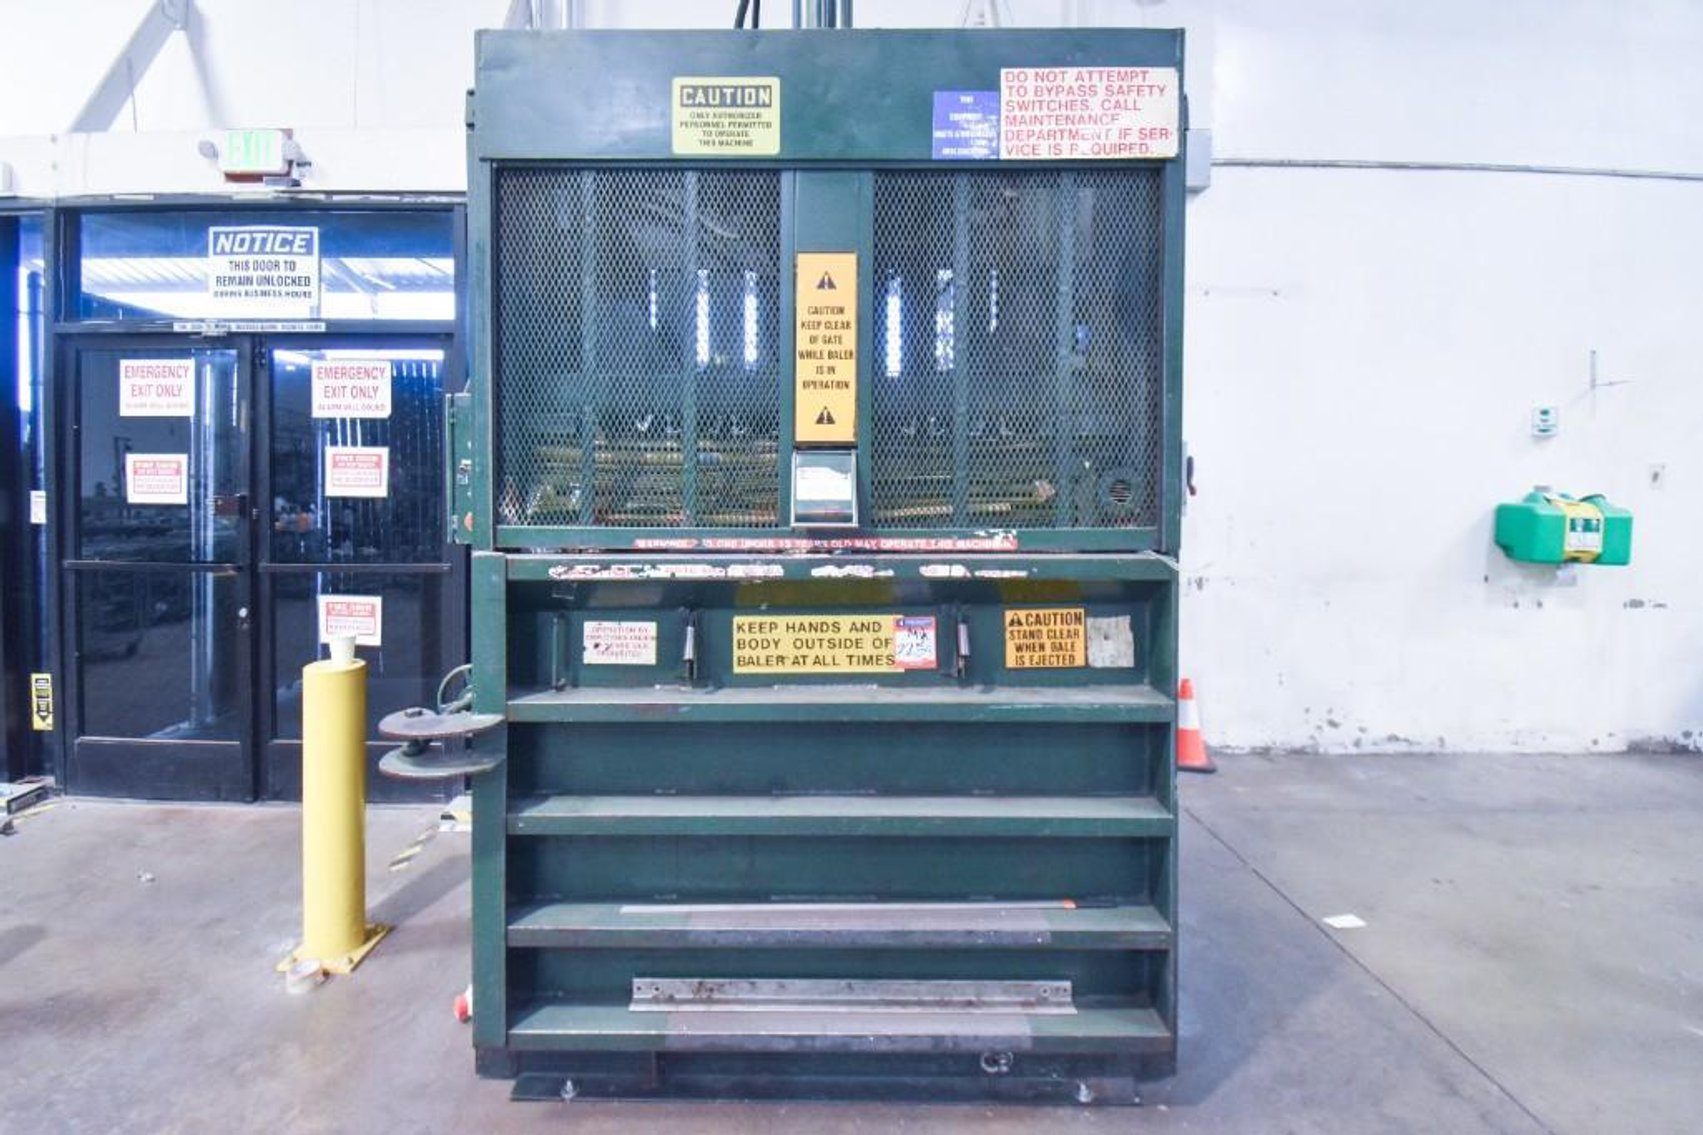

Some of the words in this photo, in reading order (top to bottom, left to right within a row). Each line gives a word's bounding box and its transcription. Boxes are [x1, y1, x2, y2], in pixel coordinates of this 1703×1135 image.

[1005, 70, 1027, 82] DO
[1034, 70, 1067, 82] NOT
[1075, 70, 1149, 82] ATTEMPT
[682, 87, 770, 105] CAUTION
[1008, 85, 1027, 97] TO
[1034, 85, 1098, 97] BYPASS
[1105, 84, 1167, 97] SAFETY
[1100, 98, 1142, 111] CALL
[1119, 128, 1132, 141] IF
[225, 131, 276, 166] EXIT
[1005, 143, 1041, 156] VICE
[1048, 143, 1063, 156] IS
[216, 232, 310, 253] NOTICE
[229, 260, 250, 272] THIS
[253, 259, 280, 272] DOOR
[284, 260, 297, 272] TO
[216, 276, 253, 287] REMAIN
[256, 275, 311, 287] UNLOCKED
[807, 306, 845, 315] CAUTION
[801, 320, 821, 330] KEEP
[824, 320, 851, 330] CLEAR
[809, 334, 819, 344] OF
[822, 334, 843, 345] GATE
[798, 350, 824, 360] WHILE
[827, 350, 853, 360] BALER
[125, 365, 189, 379] EMERGENCY
[317, 366, 385, 380] EMERGENCY
[816, 366, 824, 375] IS
[827, 366, 836, 375] IN
[131, 384, 153, 397] EXIT
[156, 384, 182, 397] ONLY
[802, 380, 849, 390] OPERATION
[324, 385, 347, 398] EXIT
[350, 385, 378, 398] ONLY
[1025, 612, 1082, 626] CAUTION
[737, 622, 778, 634] KEEP
[786, 622, 841, 633] HANDS
[849, 622, 882, 633] AND
[1009, 629, 1043, 640] STAND
[1047, 628, 1080, 640] CLEAR
[737, 639, 780, 650] BODY
[793, 638, 862, 650] OUTSIDE
[872, 638, 893, 650] OF
[1014, 642, 1045, 653] WHEN
[1050, 642, 1076, 652] BALE
[737, 655, 786, 667] BALER
[791, 655, 808, 666] AT
[813, 655, 840, 666] ALL
[846, 655, 896, 666] TIMES
[1015, 655, 1025, 666] IS
[1029, 654, 1075, 666] EJECTED
